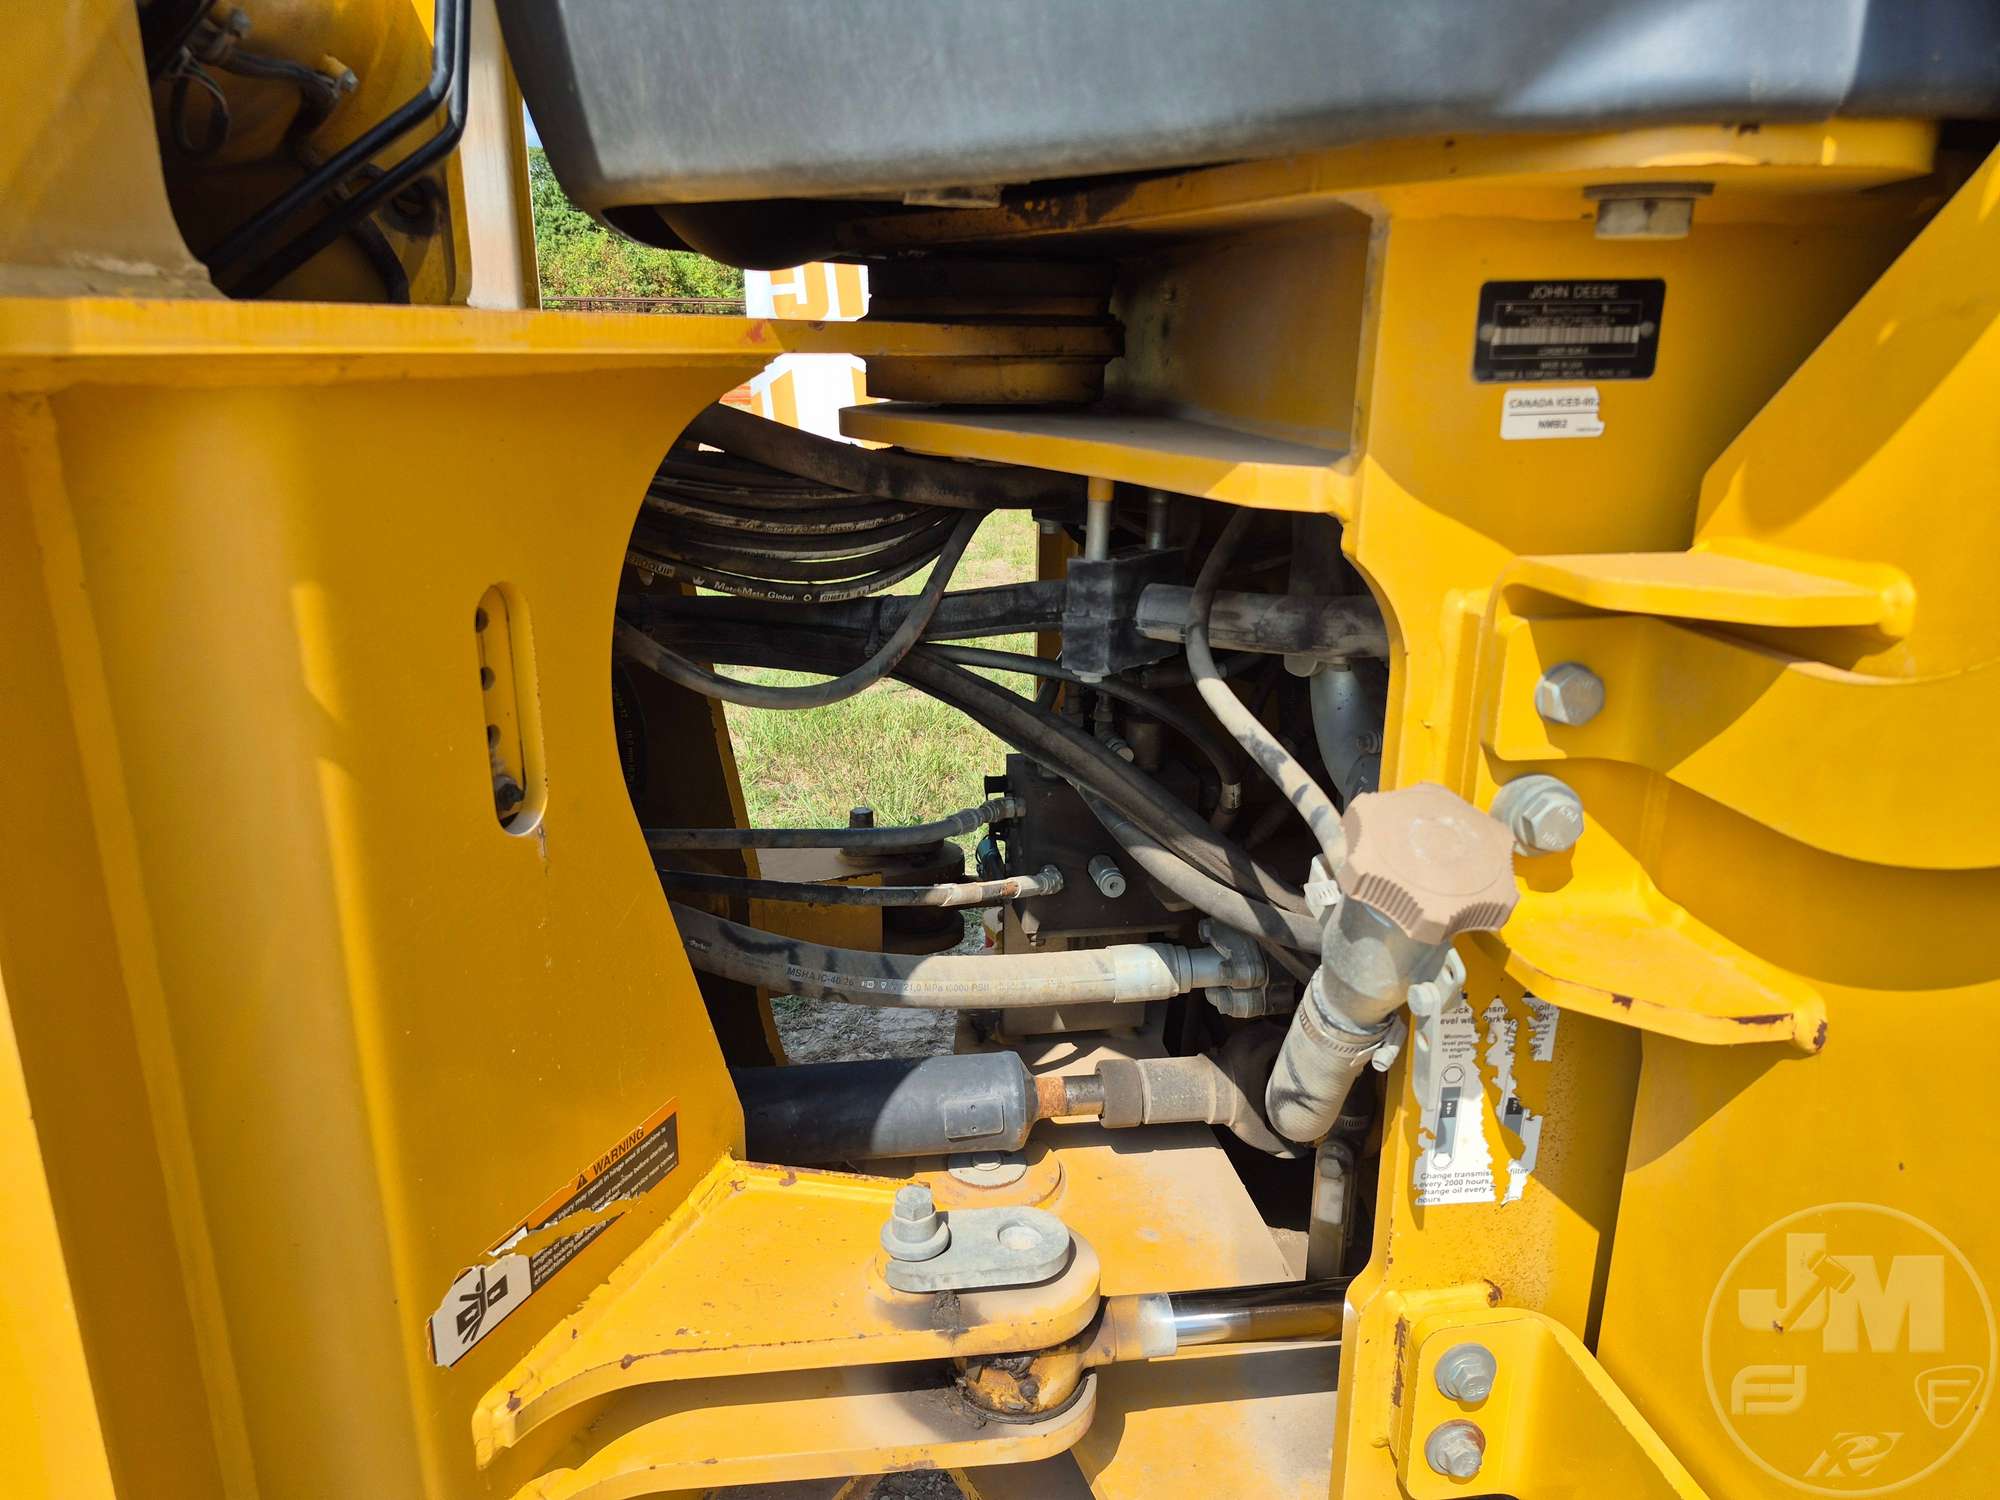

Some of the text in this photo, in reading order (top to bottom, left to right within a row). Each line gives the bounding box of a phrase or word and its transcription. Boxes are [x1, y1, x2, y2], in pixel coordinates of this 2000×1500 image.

[1530, 285, 1619, 299] JOHN DEERE
[1509, 400, 1554, 410] CANADA
[767, 591, 795, 601] Global
[787, 965, 815, 981] MSHA
[1440, 1016, 1460, 1025] evel
[593, 1128, 645, 1175] WARNING
[1420, 1171, 1452, 1181] Change
[1419, 1181, 1442, 1189] every
[1444, 1179, 1464, 1187] 2000
[1464, 1185, 1488, 1193] every
